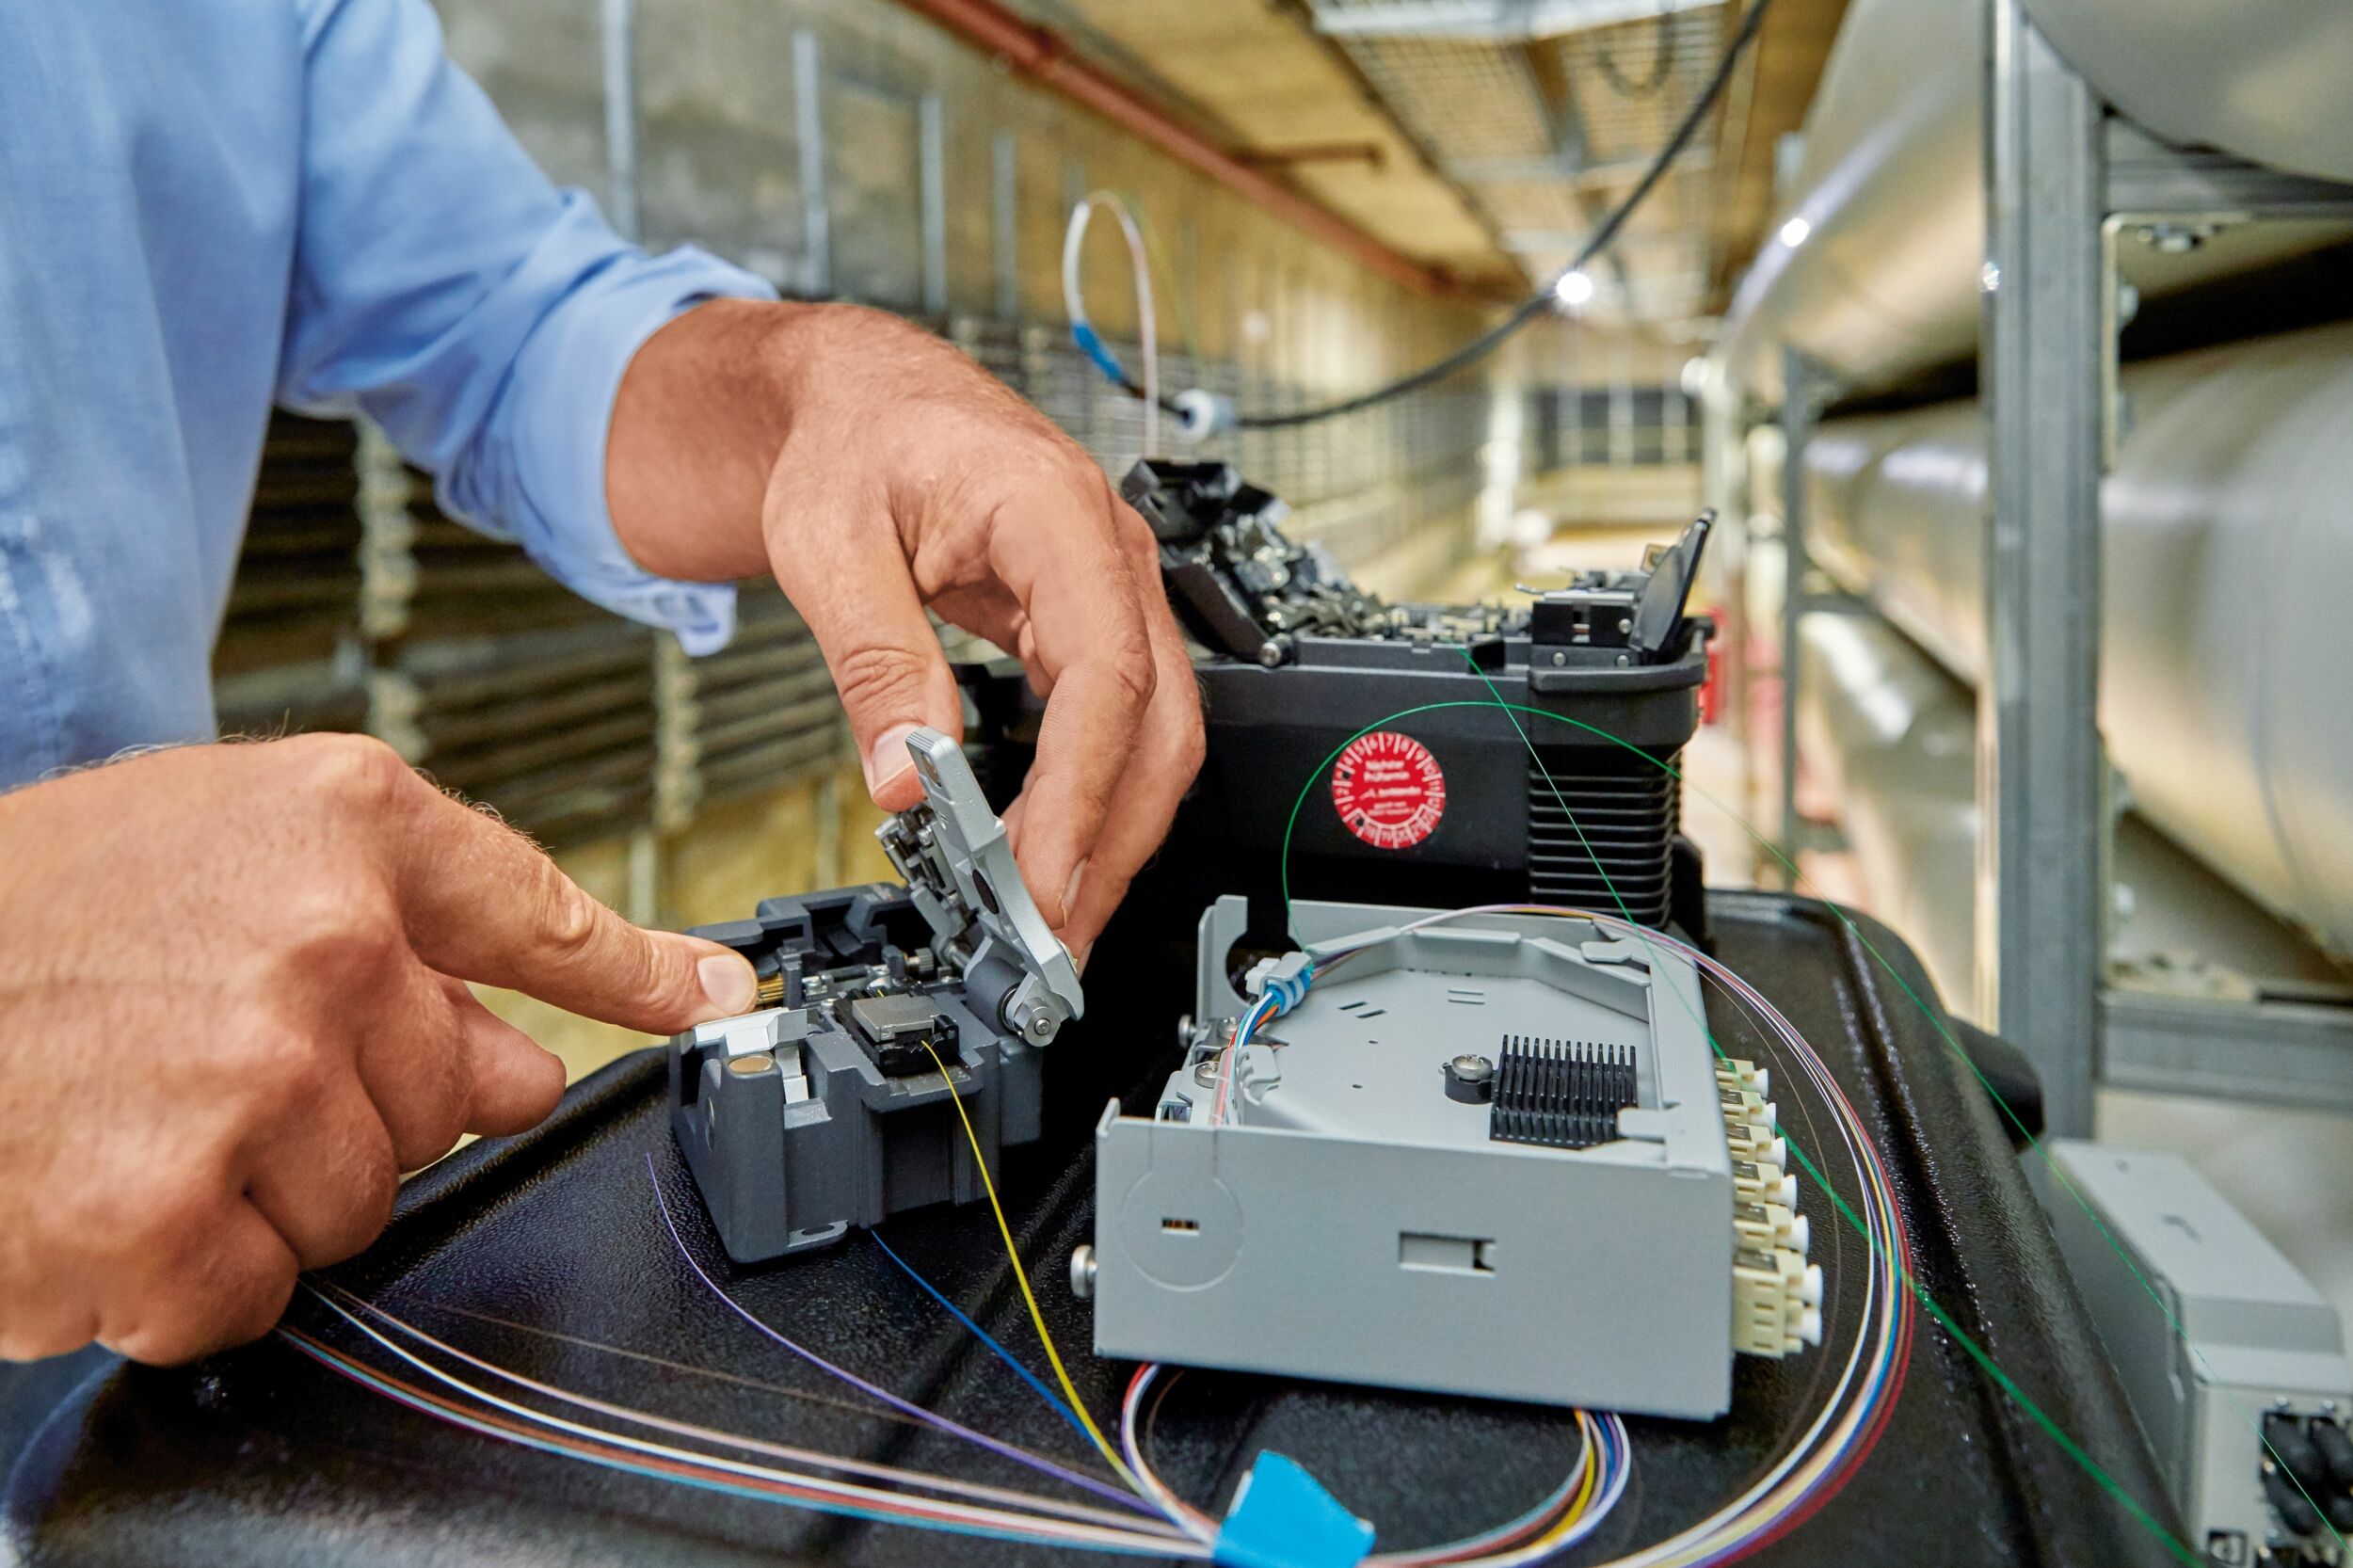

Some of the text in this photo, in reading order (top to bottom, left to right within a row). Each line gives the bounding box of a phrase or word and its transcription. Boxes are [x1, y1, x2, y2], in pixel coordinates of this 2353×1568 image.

[1385, 734, 1395, 747] 7
[1400, 739, 1411, 752] 8
[1353, 744, 1366, 755] 5
